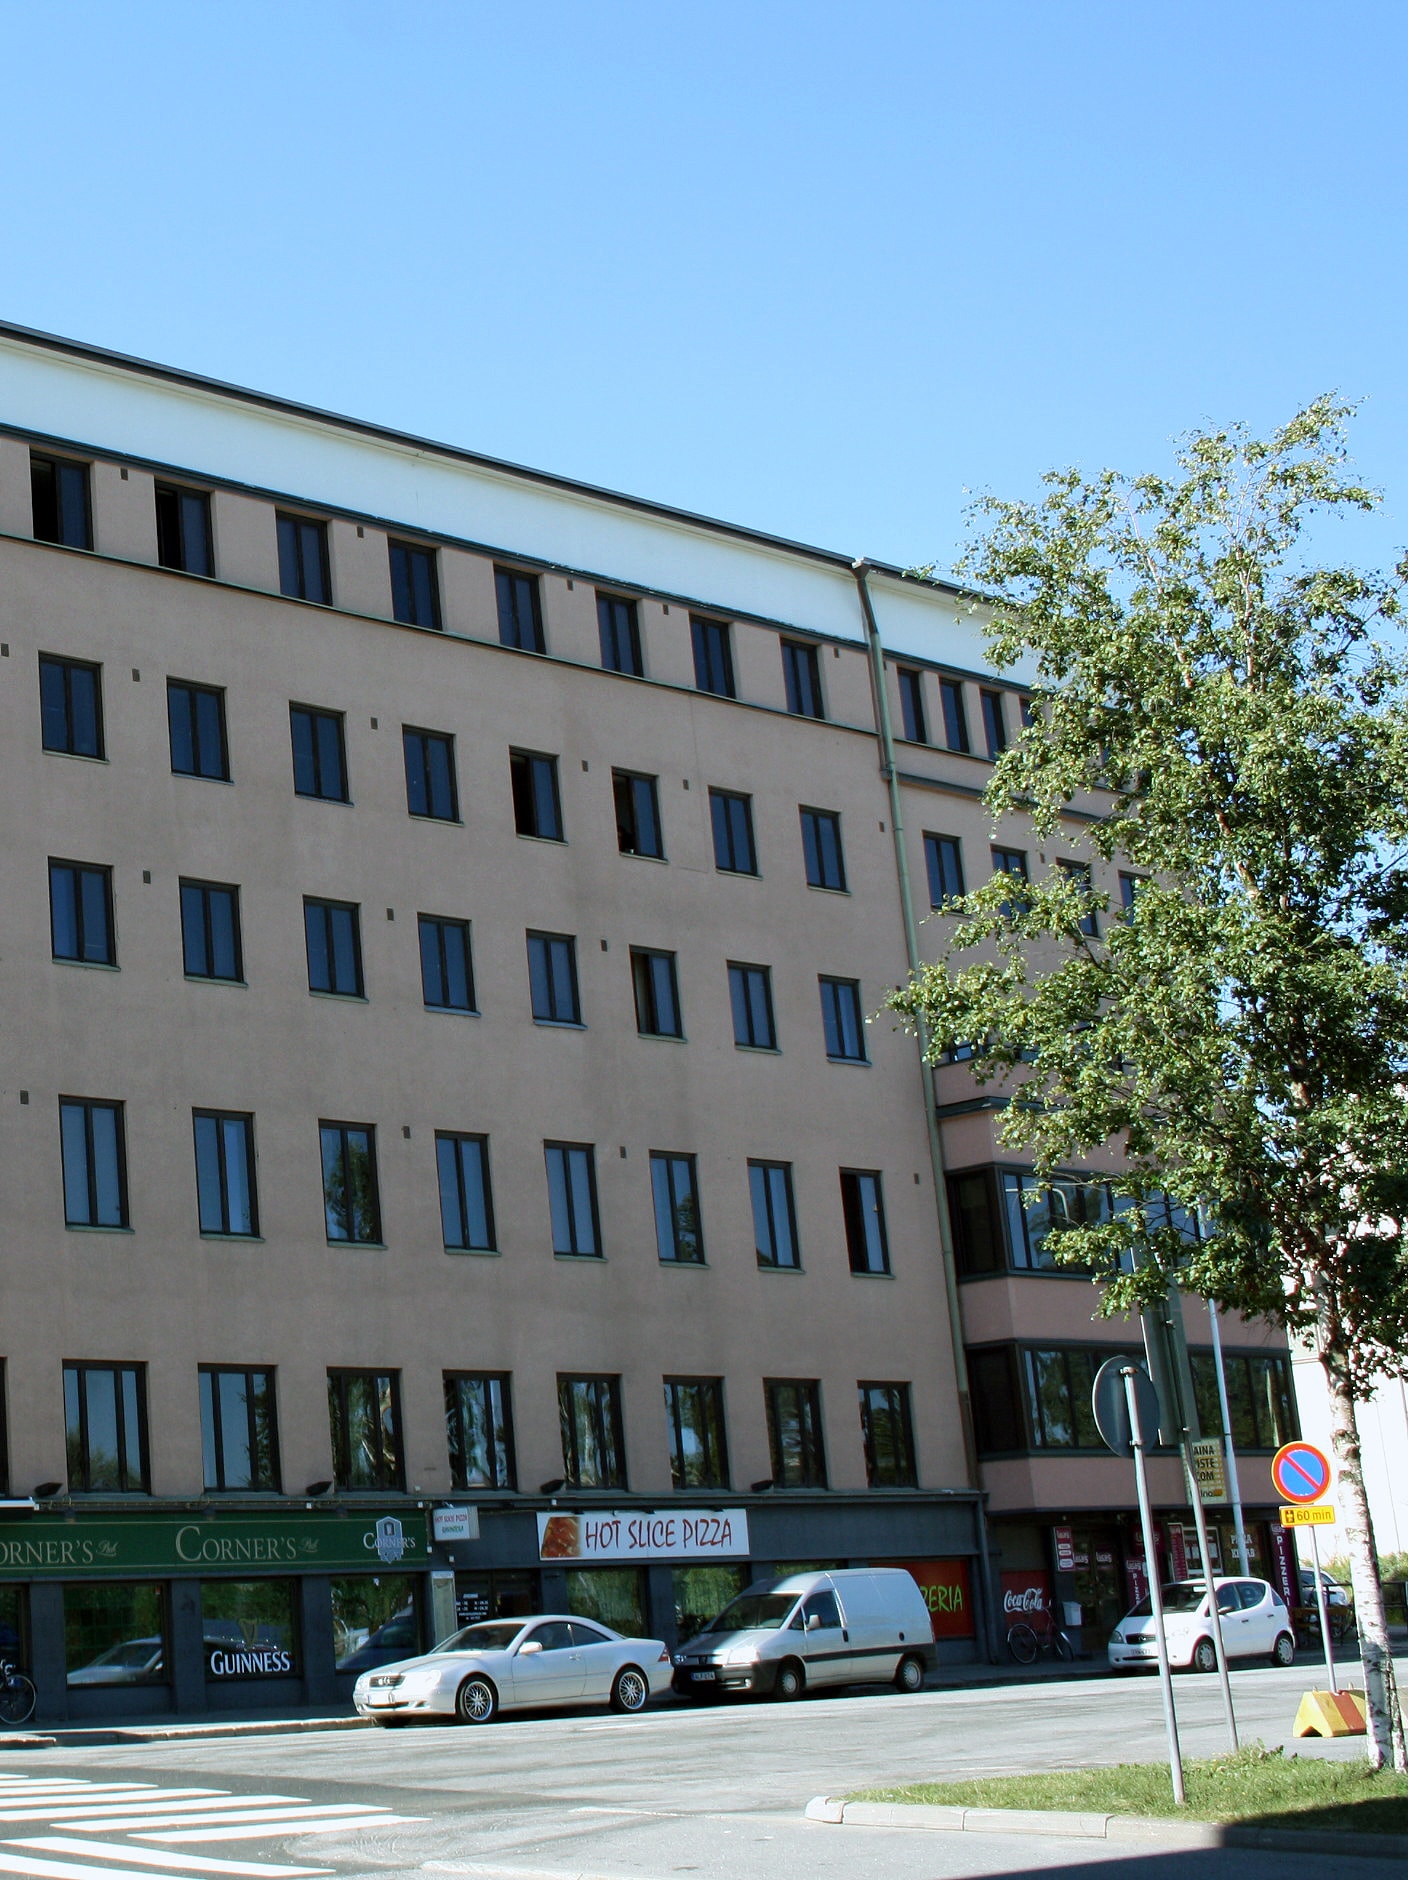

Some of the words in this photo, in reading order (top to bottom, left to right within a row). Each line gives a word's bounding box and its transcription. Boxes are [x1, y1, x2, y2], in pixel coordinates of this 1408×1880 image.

[1297, 1510, 1310, 1521] 60
[1312, 1508, 1332, 1521] min
[175, 1525, 297, 1562] CORNER'S
[585, 1519, 621, 1552] HOT
[628, 1519, 677, 1549] SLICE
[682, 1518, 732, 1549] PIZZA
[210, 1650, 291, 1675] GUINNESS
